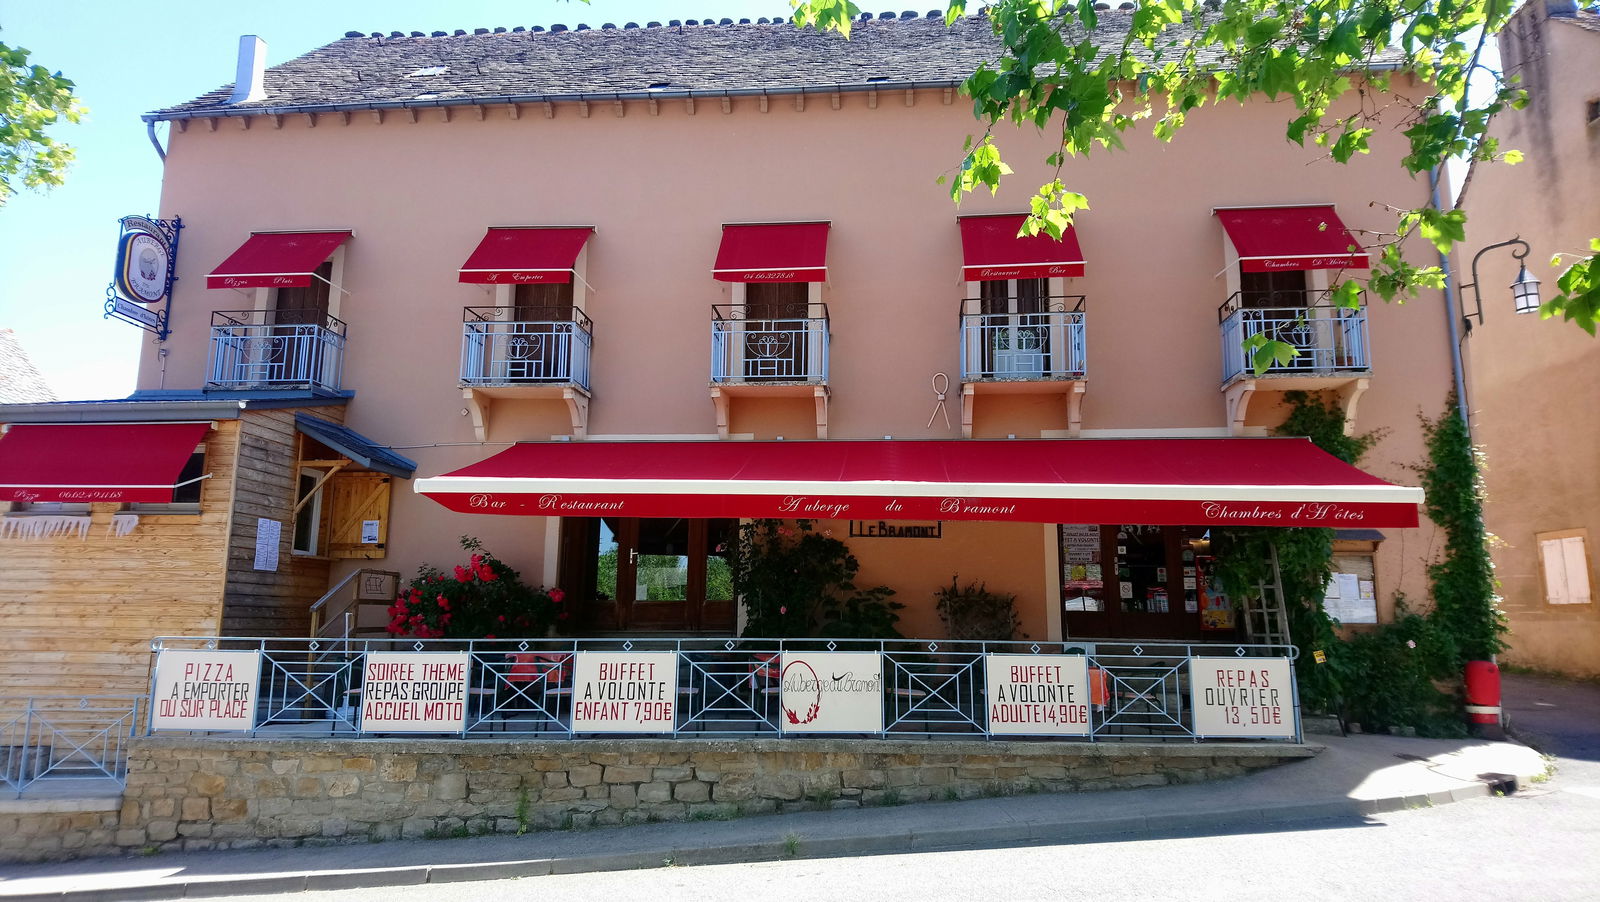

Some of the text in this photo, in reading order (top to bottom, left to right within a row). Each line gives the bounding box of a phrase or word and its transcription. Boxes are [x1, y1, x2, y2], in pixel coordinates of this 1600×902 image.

[981, 266, 1066, 277] Restaurant Bar
[1264, 260, 1299, 268] Chambres
[512, 273, 544, 282] Emporter
[14, 489, 40, 500] Pizza
[470, 493, 507, 508] Bar
[538, 494, 624, 510] Restaurant
[778, 496, 1016, 517] Auberge du Bramont
[1201, 501, 1282, 519] Chambres
[184, 663, 233, 682] PIZZA
[368, 663, 465, 681] SOIREE THEME
[600, 663, 655, 681] BUFFET
[1010, 665, 1061, 684] BUFFET
[1216, 670, 1270, 688] REPAS
[171, 682, 249, 701] A EMPORTER
[584, 682, 666, 701] A VOLONTE
[998, 684, 1075, 703] A VOLONTE
[1205, 688, 1279, 707] OUVRIER
[160, 700, 248, 719] OU SUR PLACE
[365, 702, 463, 721] ACCUEIL MOTO
[575, 702, 672, 724] ENFANT 7,90€
[991, 704, 1088, 727] ADULTE 14,90€
[1225, 706, 1281, 727] 13,50€
